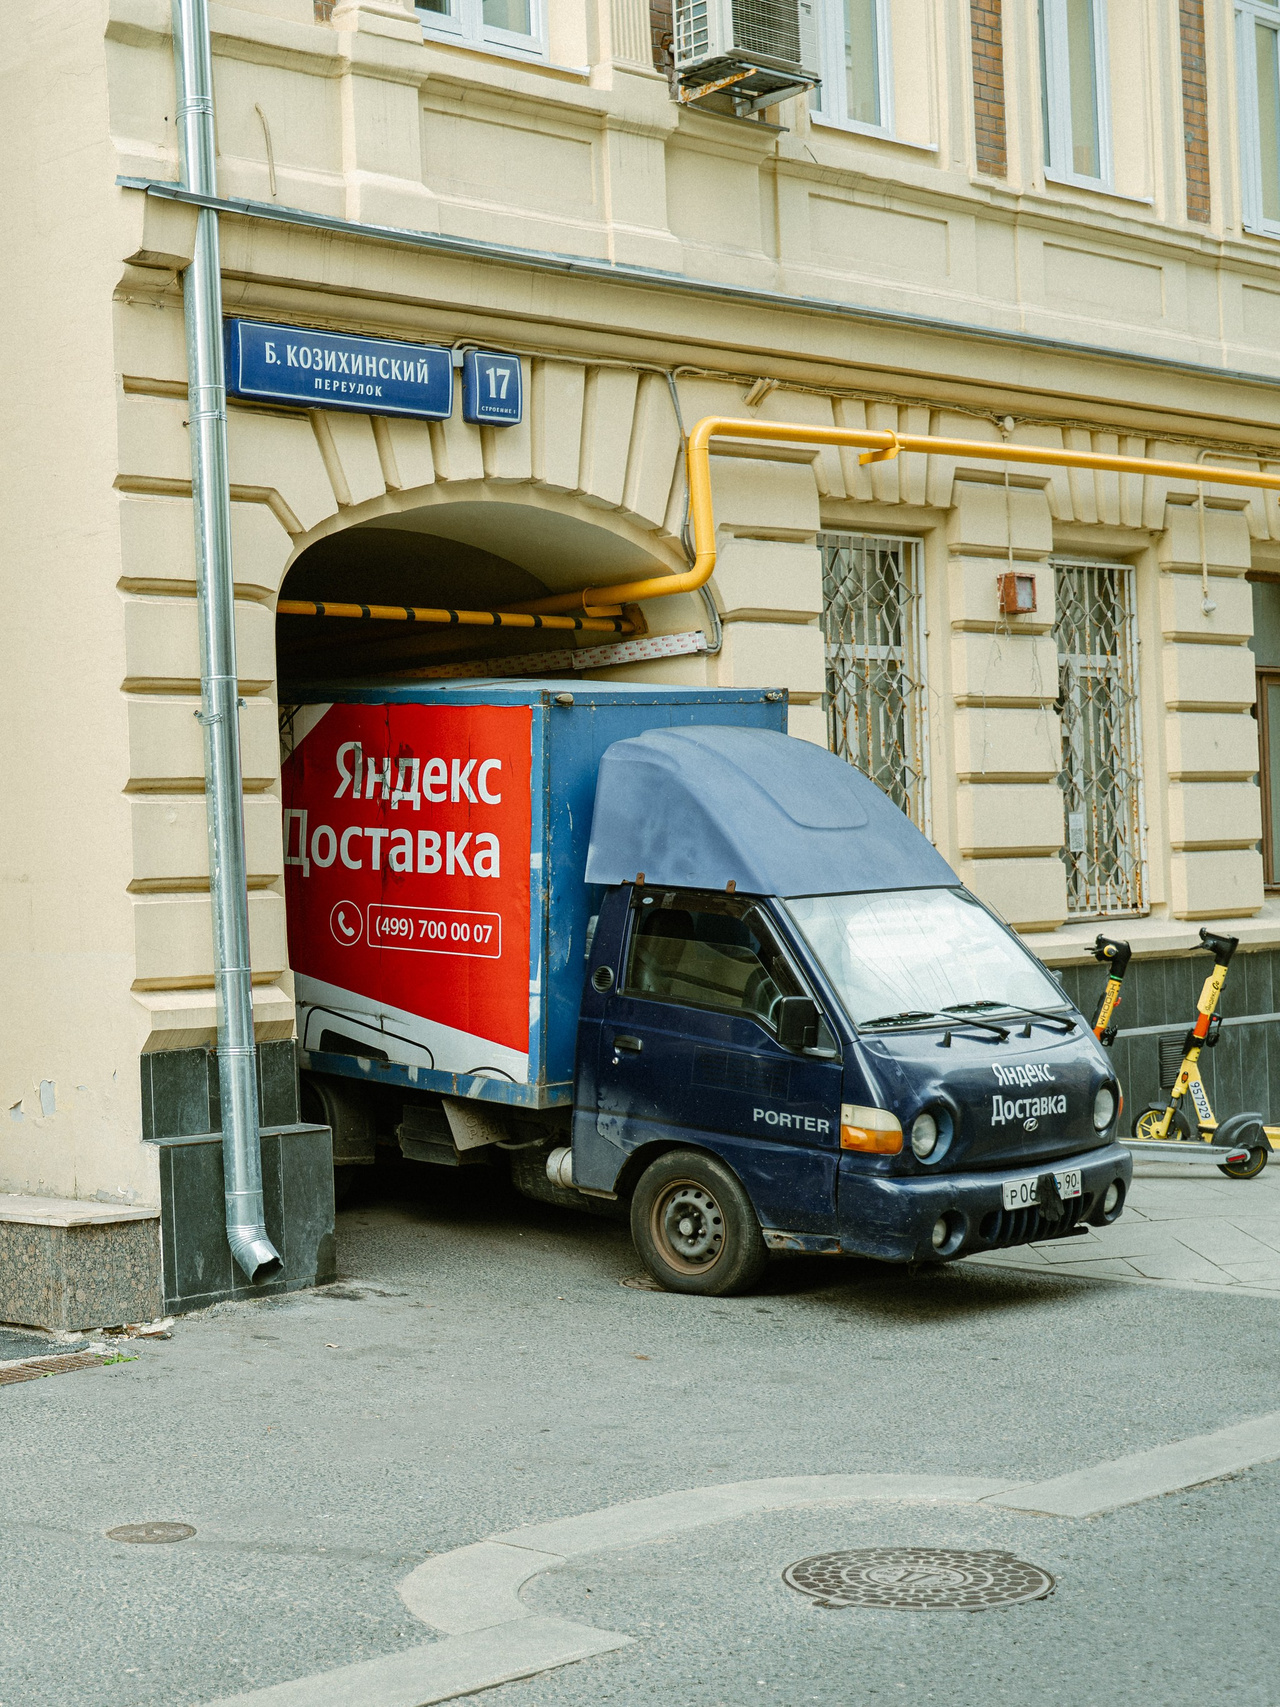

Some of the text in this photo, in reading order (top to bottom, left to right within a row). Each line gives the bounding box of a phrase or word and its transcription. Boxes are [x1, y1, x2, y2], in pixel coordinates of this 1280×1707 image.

[264, 341, 429, 385] Б. КОЗИХИНСКИЙ
[314, 377, 383, 398] ПЕРЕУЛОК
[485, 367, 510, 400] 17
[481, 405, 512, 414] СТРОЕНИЕ
[333, 741, 502, 811] Яндекс
[283, 808, 501, 878] Доставка
[375, 915, 493, 944] (499) 700 00 07
[1098, 983, 1117, 1026] WHOOSH
[991, 1062, 1056, 1087] Яндекс
[991, 1094, 1067, 1126] Доставка
[1190, 1081, 1211, 1119] 957929
[753, 1108, 830, 1134] PORTER
